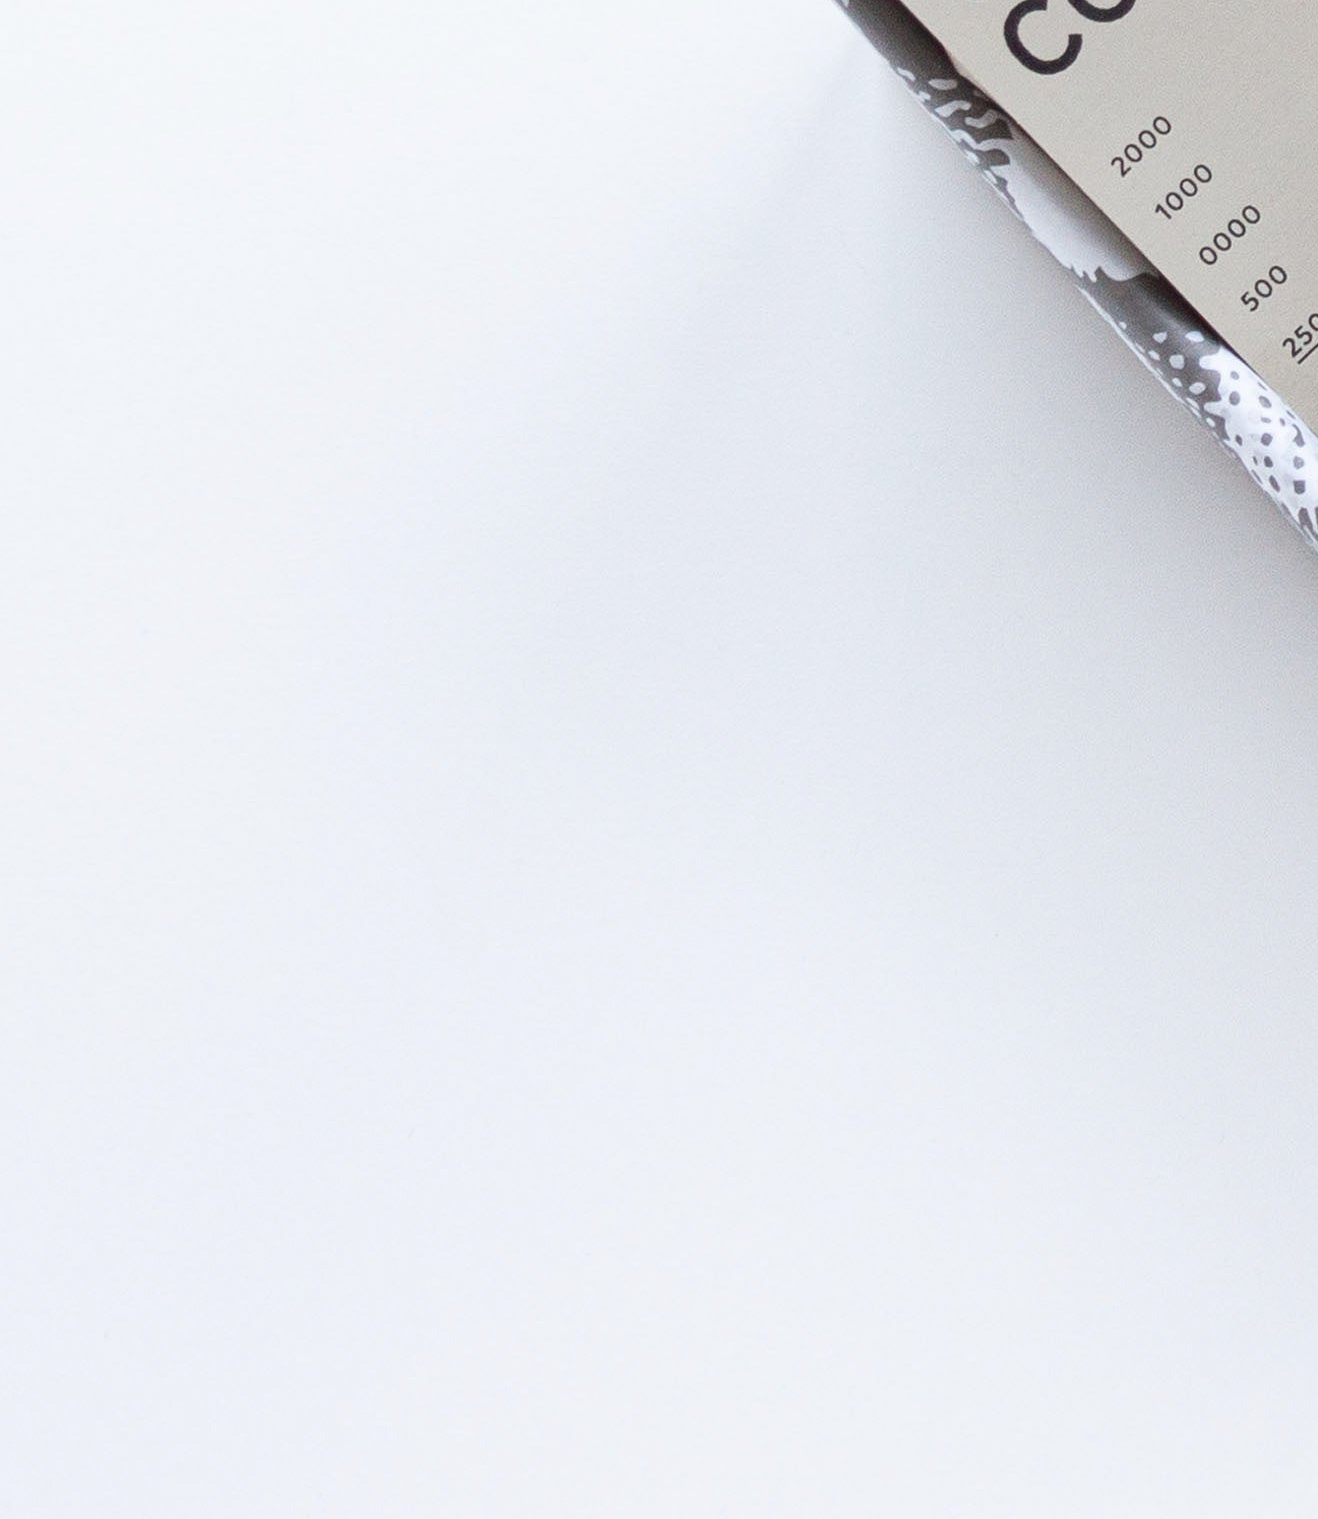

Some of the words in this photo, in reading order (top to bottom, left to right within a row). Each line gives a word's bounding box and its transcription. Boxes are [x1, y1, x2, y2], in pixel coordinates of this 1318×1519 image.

[1110, 115, 1173, 179] 2000
[1154, 162, 1214, 223] 1000
[1198, 203, 1262, 266] 0000
[1240, 264, 1289, 313] 500
